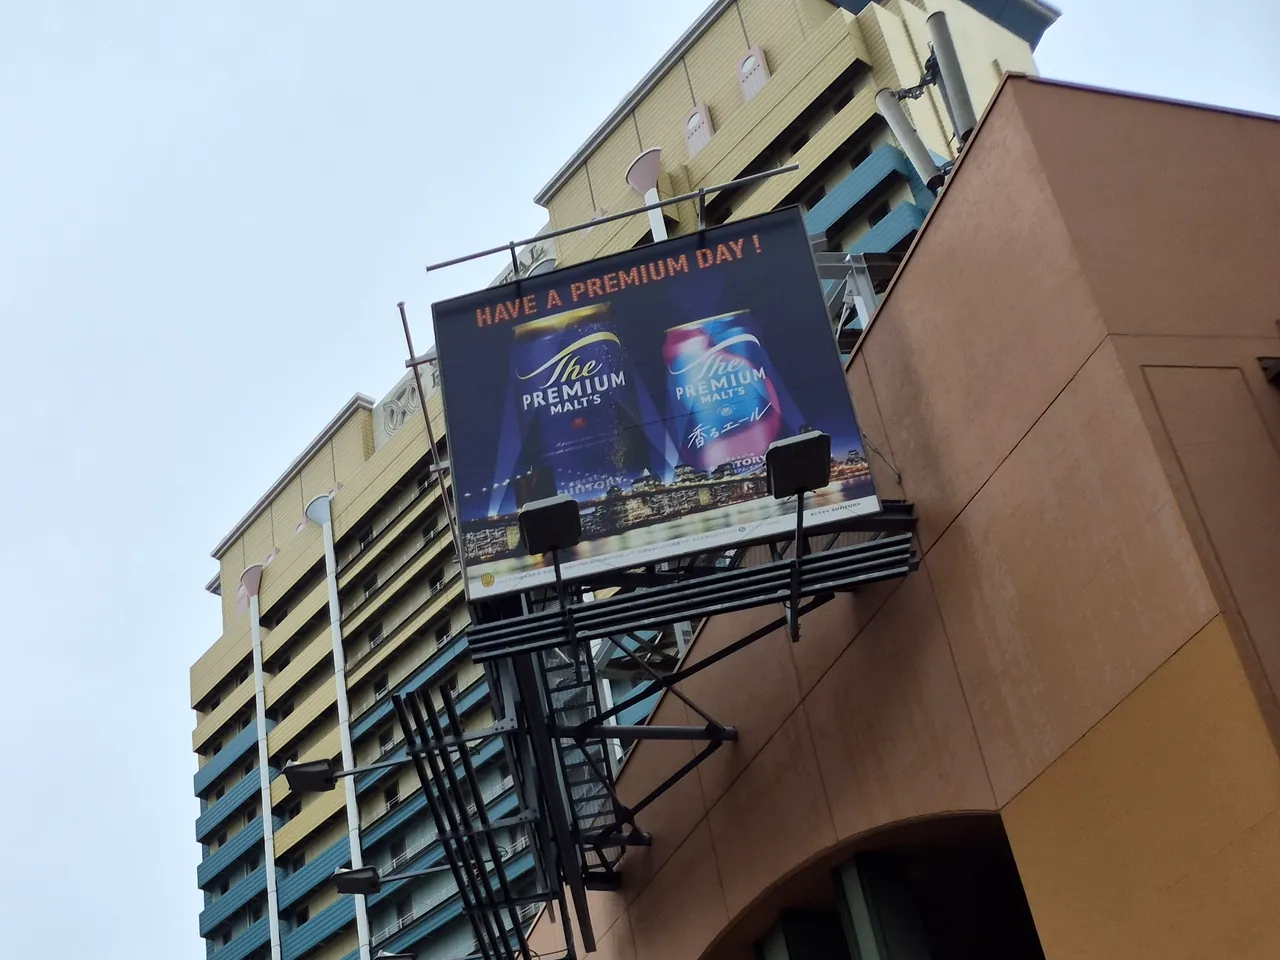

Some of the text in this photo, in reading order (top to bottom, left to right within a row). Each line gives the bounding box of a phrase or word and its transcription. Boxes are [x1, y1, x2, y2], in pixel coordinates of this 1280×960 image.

[476, 294, 537, 328] HAVE
[547, 289, 563, 309] A
[570, 253, 689, 302] PREMIUM
[696, 238, 745, 269] DAY
[522, 371, 626, 411] PREMIUM
[675, 366, 767, 400] PREMIUM
[701, 385, 747, 405] MALT'S
[550, 394, 602, 416] MALT'S
[687, 402, 772, 450] 香るエール
